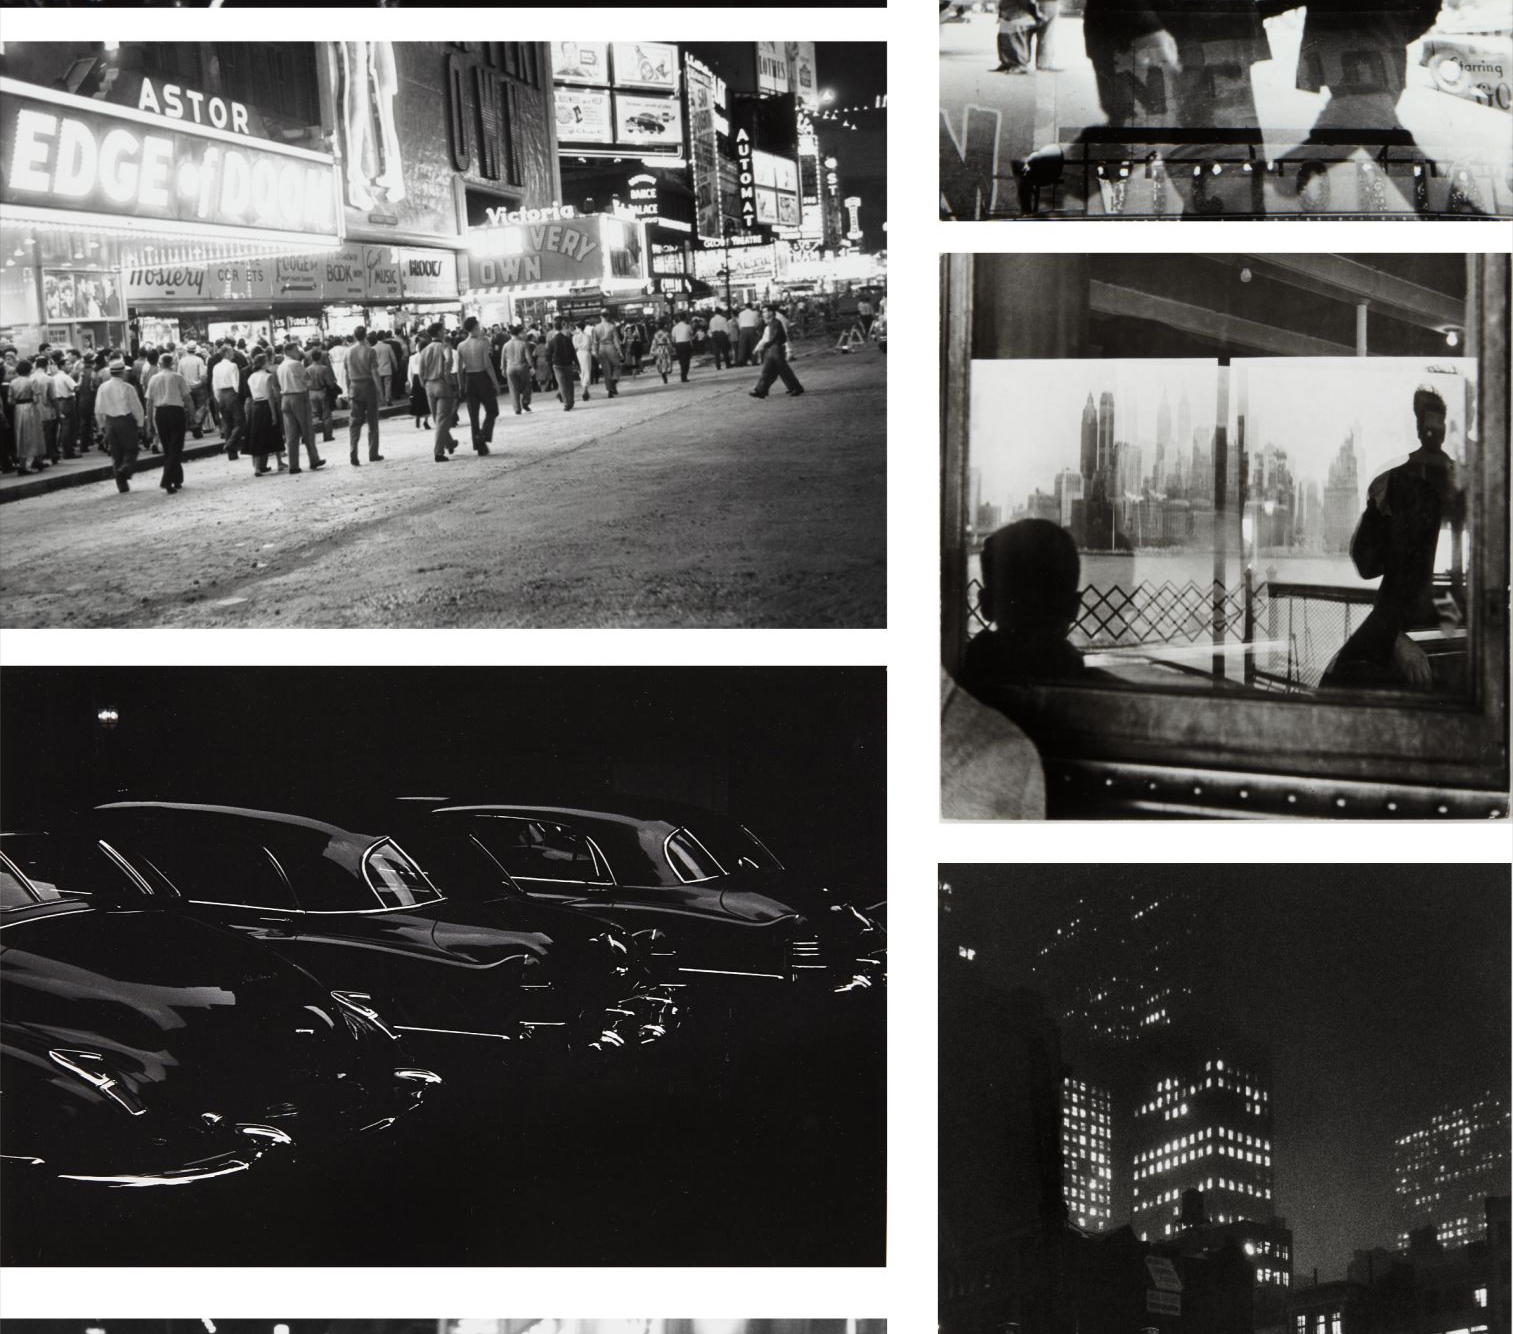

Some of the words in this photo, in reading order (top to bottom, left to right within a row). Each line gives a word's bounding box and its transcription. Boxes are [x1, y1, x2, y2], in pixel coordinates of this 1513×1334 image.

[138, 77, 250, 135] ASTOR
[8, 108, 175, 206] EDGE
[177, 145, 219, 218] of
[220, 150, 334, 231] DOOM
[736, 127, 755, 227] AUTOMAT
[485, 201, 575, 226] Victoria
[529, 224, 597, 262] VERY
[217, 268, 264, 283] CORETS
[327, 264, 353, 283] BOOK
[374, 268, 398, 284] MUSIC
[480, 254, 542, 285] OWN
